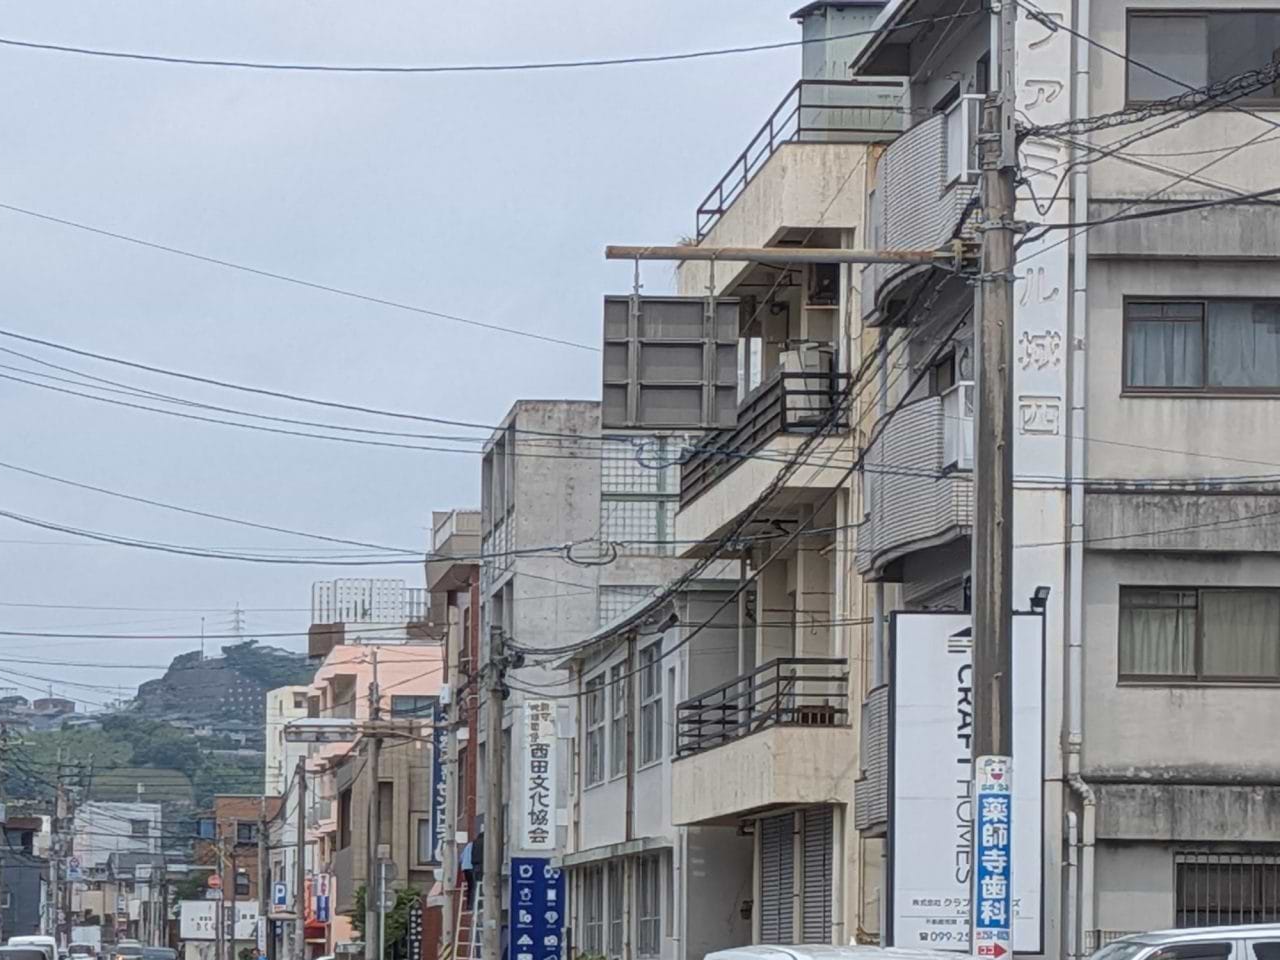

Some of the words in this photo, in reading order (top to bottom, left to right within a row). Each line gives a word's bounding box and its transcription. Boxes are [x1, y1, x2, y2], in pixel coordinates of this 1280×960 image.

[528, 743, 550, 844] 西田文化協会
[980, 798, 1008, 925] 薬師寺歯科
